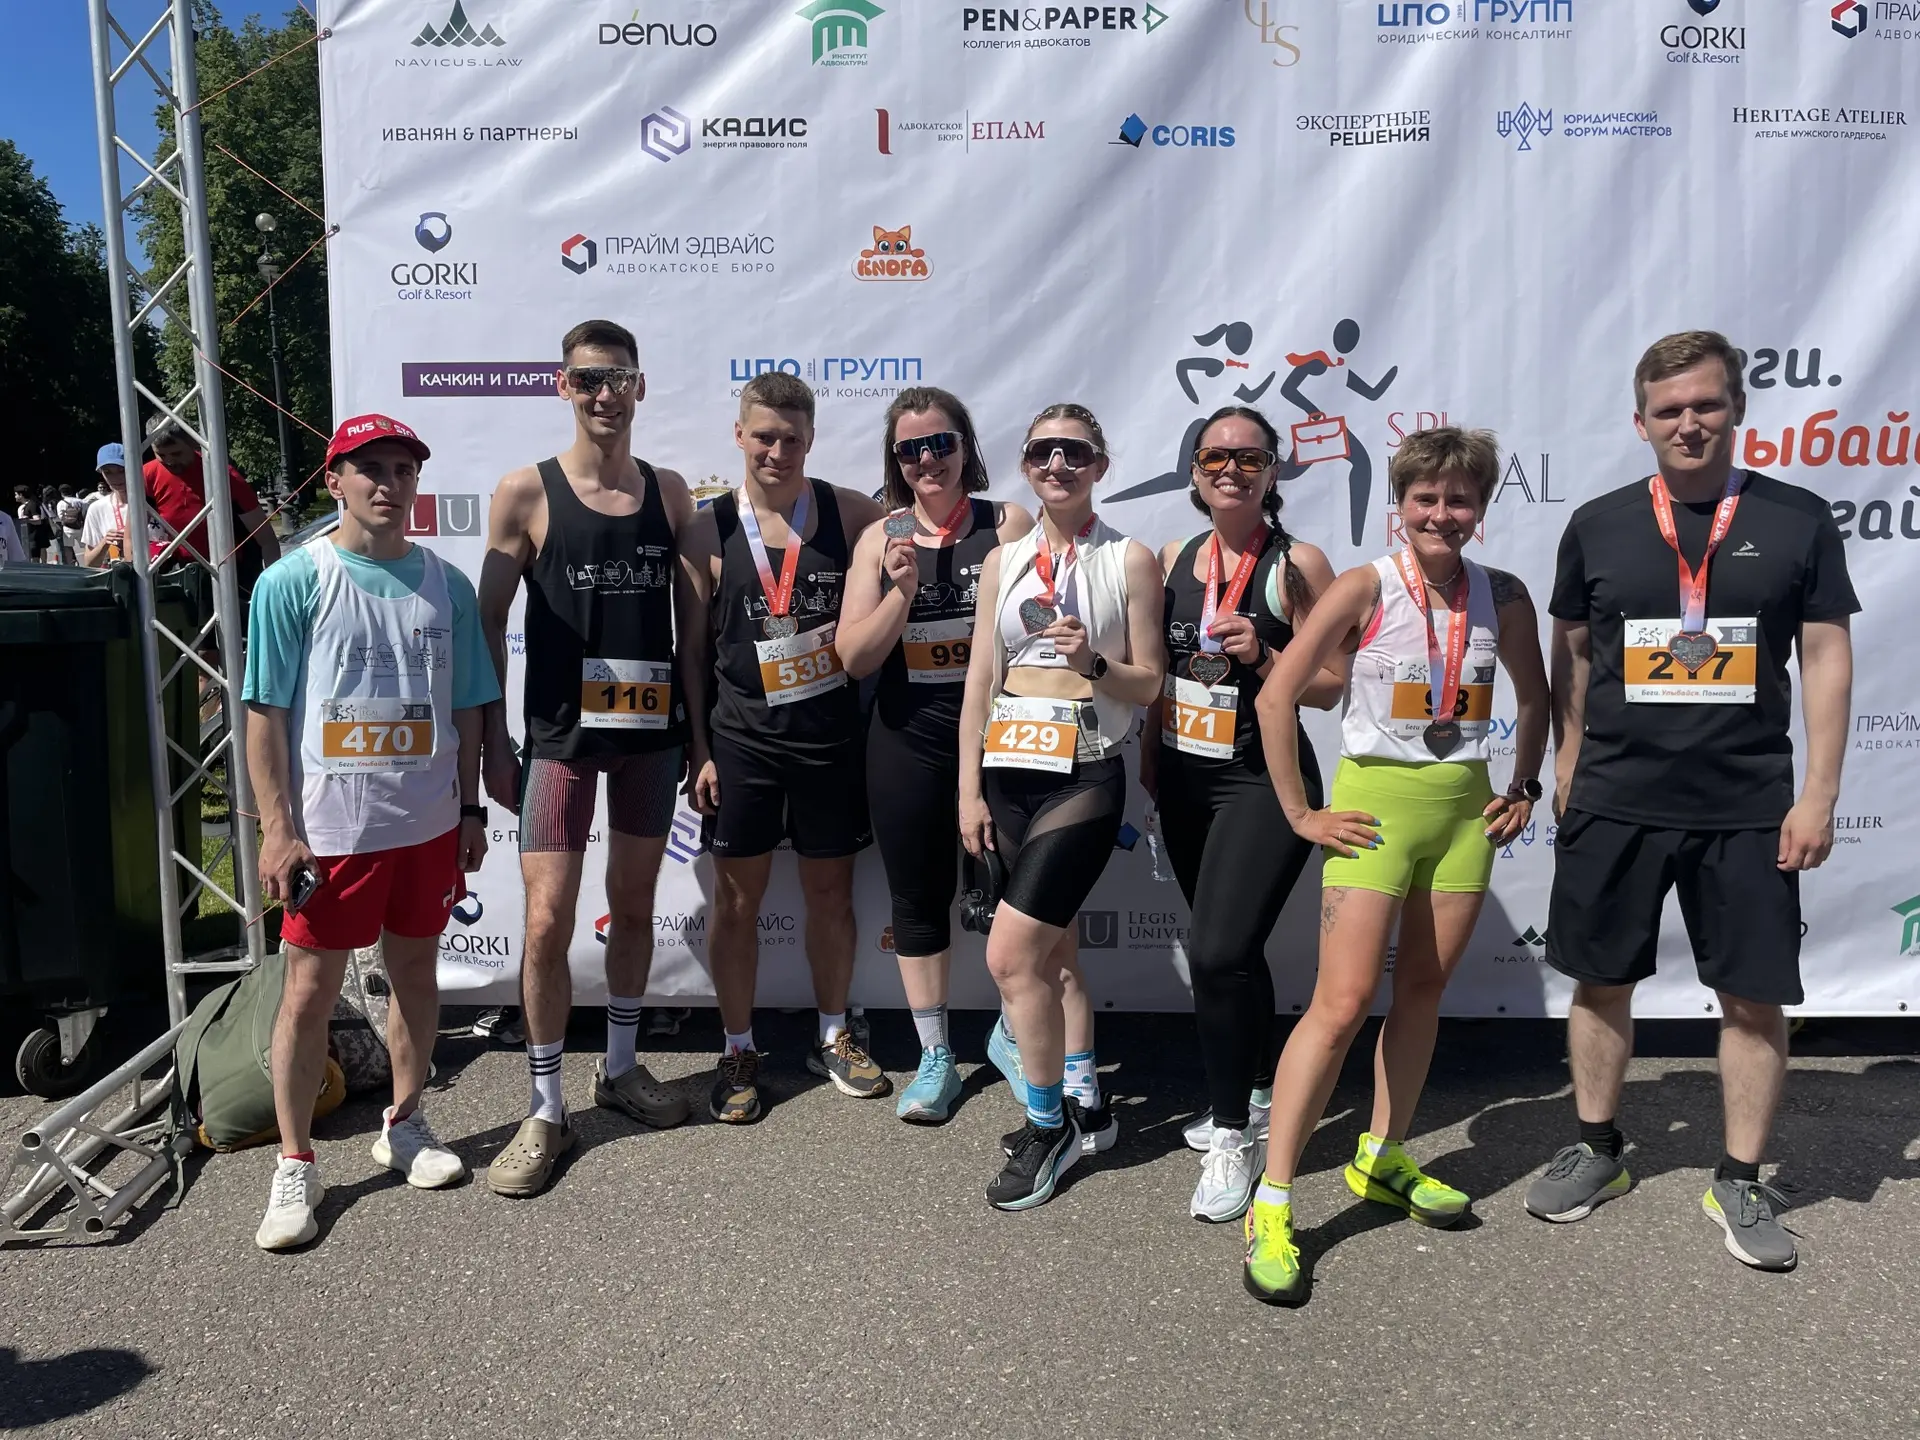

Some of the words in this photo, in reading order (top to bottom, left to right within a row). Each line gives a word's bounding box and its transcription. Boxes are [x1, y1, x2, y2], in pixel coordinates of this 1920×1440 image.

[1378, 3, 1451, 26] ЦПО
[1474, 0, 1572, 23] ГРУПП
[963, 39, 1020, 49] коллегия
[1024, 38, 1091, 48] адвокатов
[1377, 28, 1479, 44] ЮРИДИЧЕСКИЙ
[1486, 29, 1572, 40] КОНСАЛТИНГ
[1660, 24, 1746, 49] GORKI
[395, 58, 523, 67] NAVICUS.LAW
[1667, 51, 1690, 63] Golf
[1296, 110, 1431, 130] ЭКСПЕРТНЫЕ
[1564, 111, 1657, 124] ЮРИДИЧЕСКИЙ
[463, 127, 475, 141] &
[702, 117, 808, 137] КАДИС
[898, 122, 963, 131] АДВОКАТСКОЕ
[972, 121, 1046, 140] ЕПАМ
[1152, 125, 1235, 147] CORIS
[1564, 126, 1608, 137] ФОРУМ
[1612, 126, 1672, 137] МАСТЕРОВ
[1755, 130, 1788, 139] АТЕЛЬЕ
[1791, 130, 1839, 139] МУЖСКОГО
[1841, 131, 1887, 140] ГАРДЕРОБА
[702, 141, 738, 149] энергия
[739, 141, 784, 149] правового
[938, 133, 963, 141] БЮРО
[1330, 127, 1430, 146] РЕШЕНИЯ
[606, 233, 679, 255] ПРАЙМ
[686, 233, 775, 258] ЭДВАЙС
[391, 262, 478, 285] GORKI
[607, 263, 719, 274] АДВОКАТСКОЕ
[731, 263, 775, 273] БЮРО
[398, 289, 422, 300] Golf
[824, 358, 922, 381] ГРУПП
[1737, 348, 1842, 389] ги.
[420, 373, 484, 386] КАЧКИН
[490, 373, 501, 386] И
[507, 373, 558, 386] ПАРТН
[837, 388, 902, 398] КОНСАЛТИ
[1732, 409, 1920, 468] ыбай
[931, 642, 970, 667] 99
[779, 651, 832, 685] 538
[1648, 651, 1733, 680] 27
[601, 685, 658, 711] 116
[1169, 704, 1216, 738] 371
[341, 725, 414, 752] 470
[999, 724, 1059, 752] 429
[1855, 739, 1920, 750] АДВОКАТ
[1834, 816, 1884, 829] ELIER
[652, 913, 705, 931] РАЙМ
[756, 913, 795, 931] АЙС
[1128, 911, 1176, 925] LEGIS
[1128, 927, 1190, 939] UNIVE
[443, 953, 461, 962] Golf
